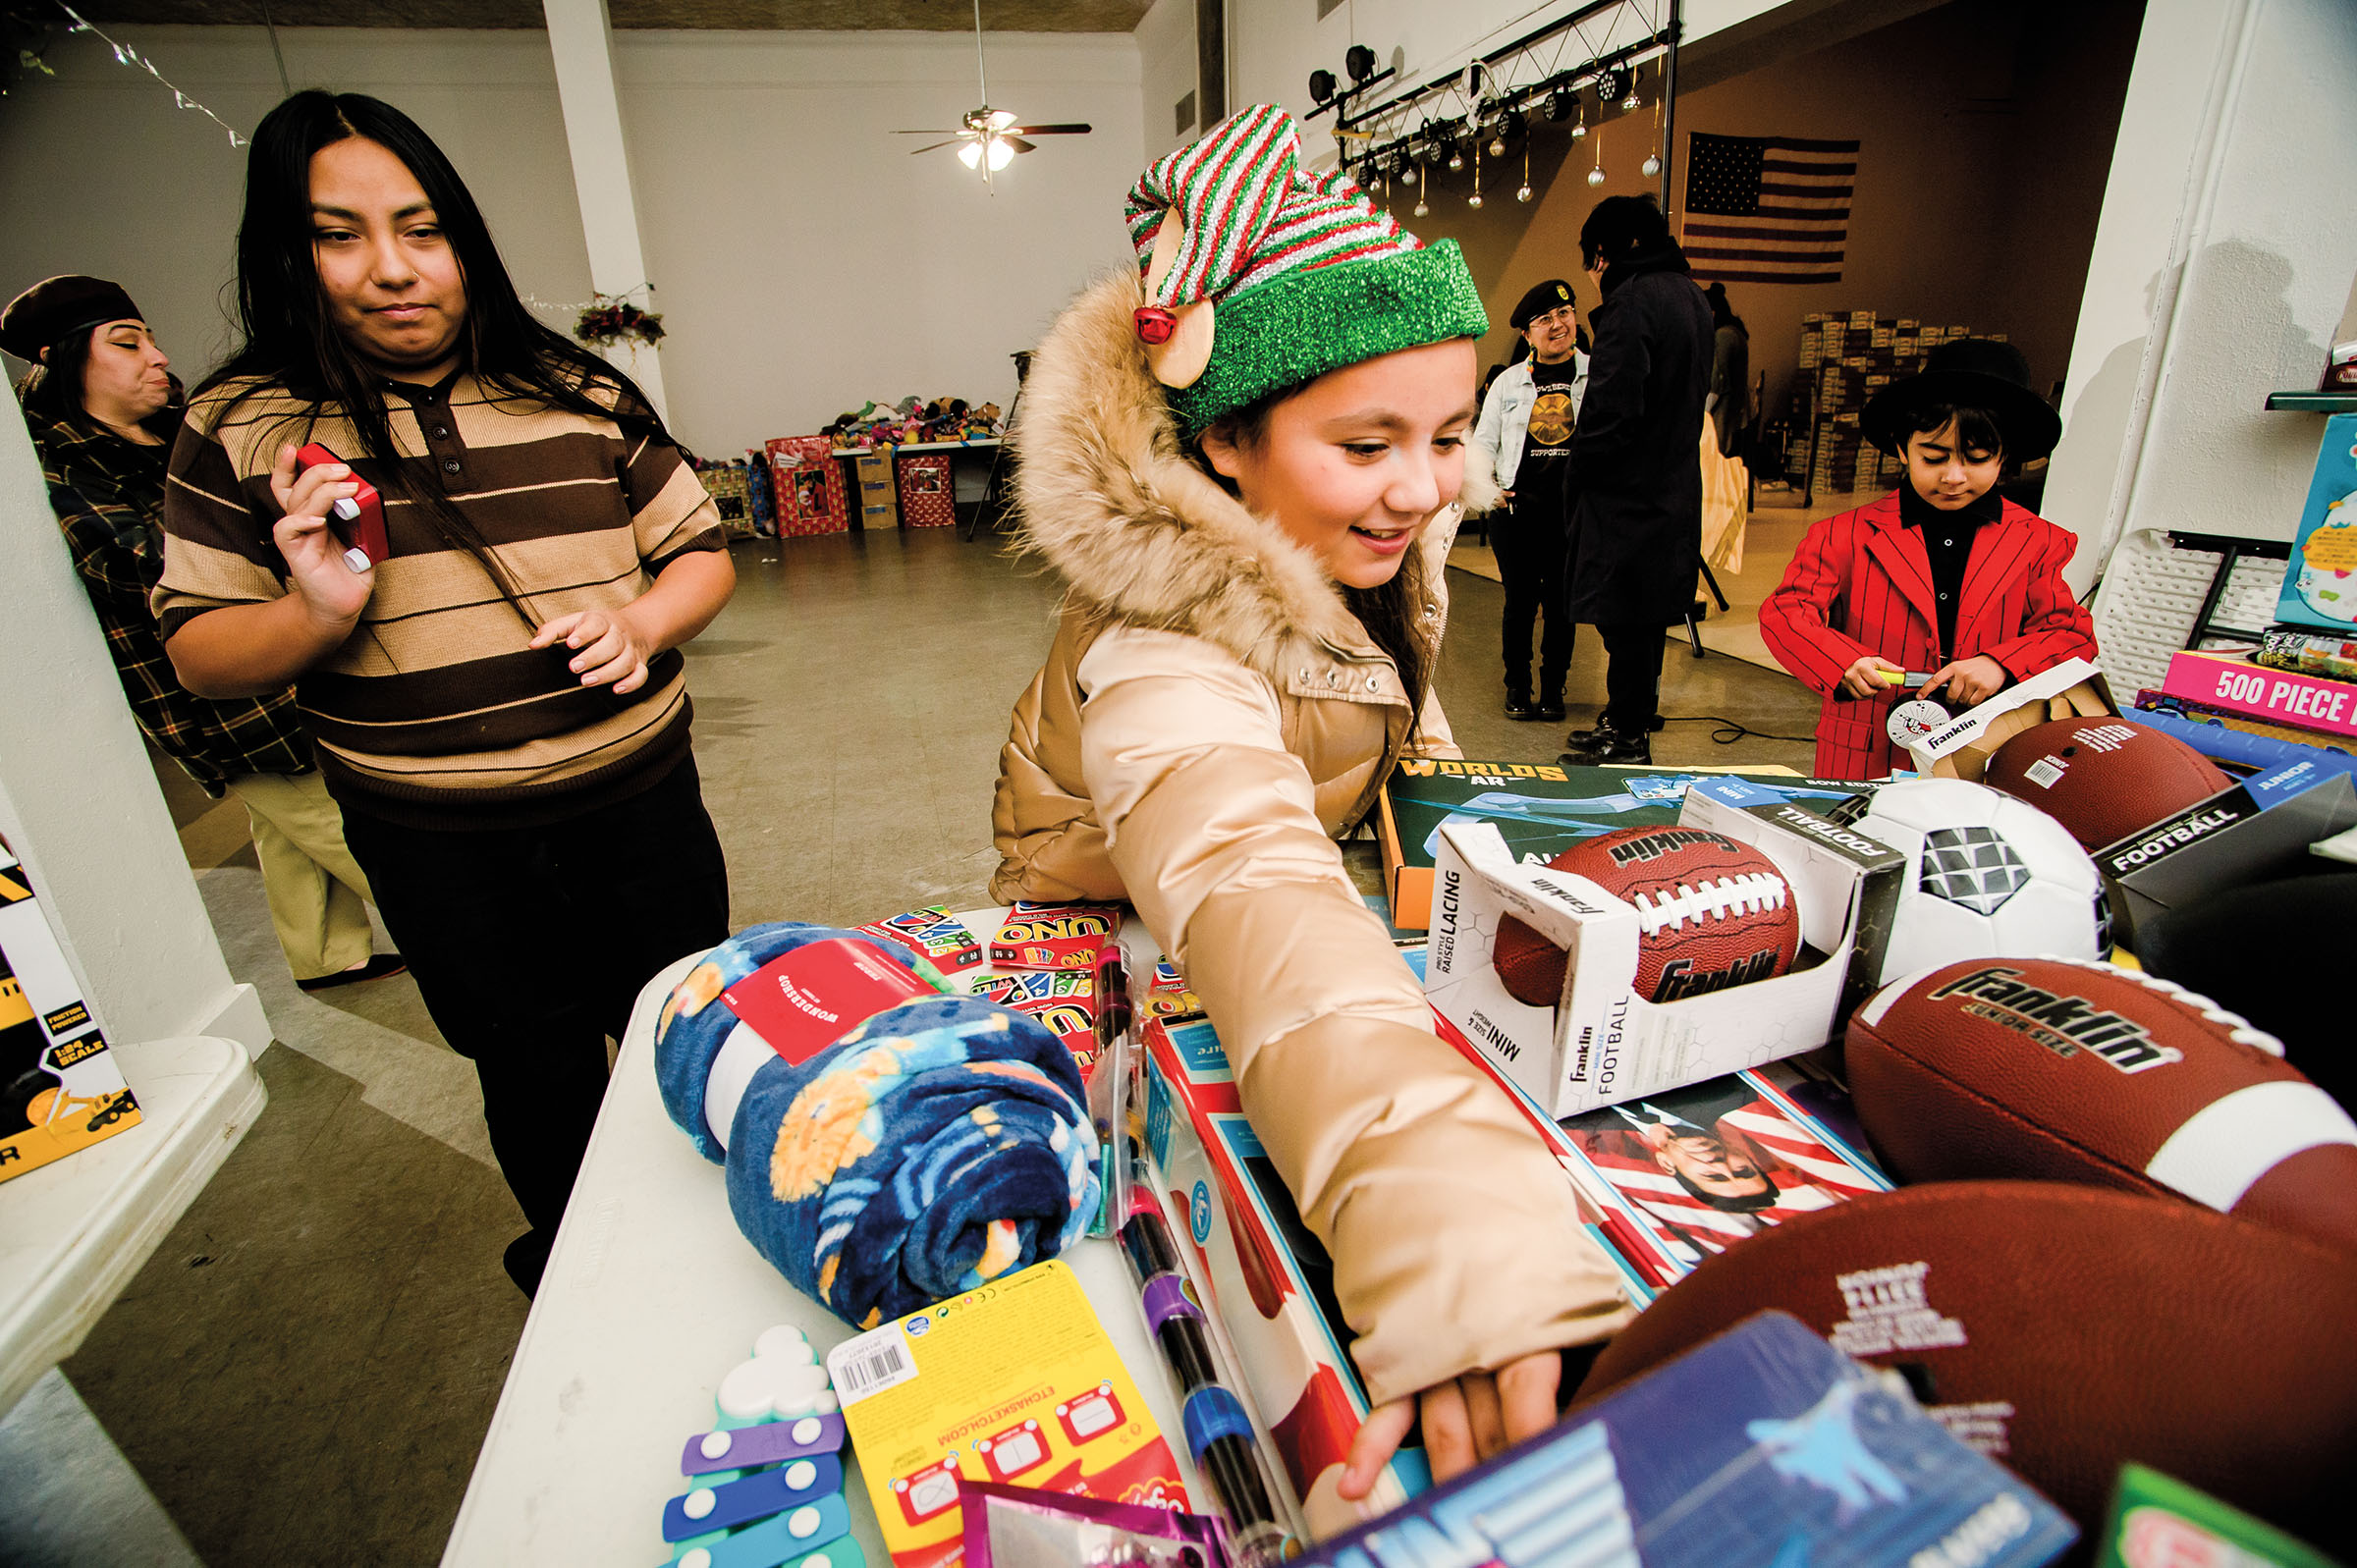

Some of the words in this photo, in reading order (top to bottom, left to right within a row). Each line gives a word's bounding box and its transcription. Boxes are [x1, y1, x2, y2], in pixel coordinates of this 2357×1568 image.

[2216, 671, 2266, 705] 500
[2268, 681, 2349, 723] PIECE
[1398, 759, 1569, 782] WORLDS
[1471, 776, 1507, 786] AR
[2258, 761, 2315, 790] JUNIOR
[1717, 785, 1745, 800] MINI
[1805, 779, 1841, 787] BOW
[1777, 806, 1888, 857] FOOTBALL
[2112, 809, 2239, 872] FOOTBALL
[1443, 870, 1460, 936] LACING
[994, 914, 1112, 945] UNO
[1061, 949, 1096, 968] UNO
[1442, 937, 1454, 974] RAISED
[969, 978, 1014, 996] WILD
[1034, 987, 1045, 997] 4
[1055, 985, 1068, 994] 3
[778, 975, 839, 1024] WONDERSHOP
[48, 1005, 83, 1025] FRICTION
[52, 1011, 87, 1031] POWERED
[1472, 1008, 1492, 1027] WEIGHT
[1473, 1023, 1487, 1037] SIZE
[1960, 1002, 2031, 1033] JUNIOR
[2027, 1027, 2080, 1058] SIZE
[55, 1040, 84, 1058] 1:24
[59, 1040, 104, 1067] SCALE
[1486, 1025, 1520, 1062] MINI
[1596, 1034, 1605, 1052] SIZE
[1599, 996, 1629, 1095] FOOTBALL
[1593, 1052, 1602, 1069] MINI
[938, 1385, 1056, 1447] ETCHASKETCH.COM
